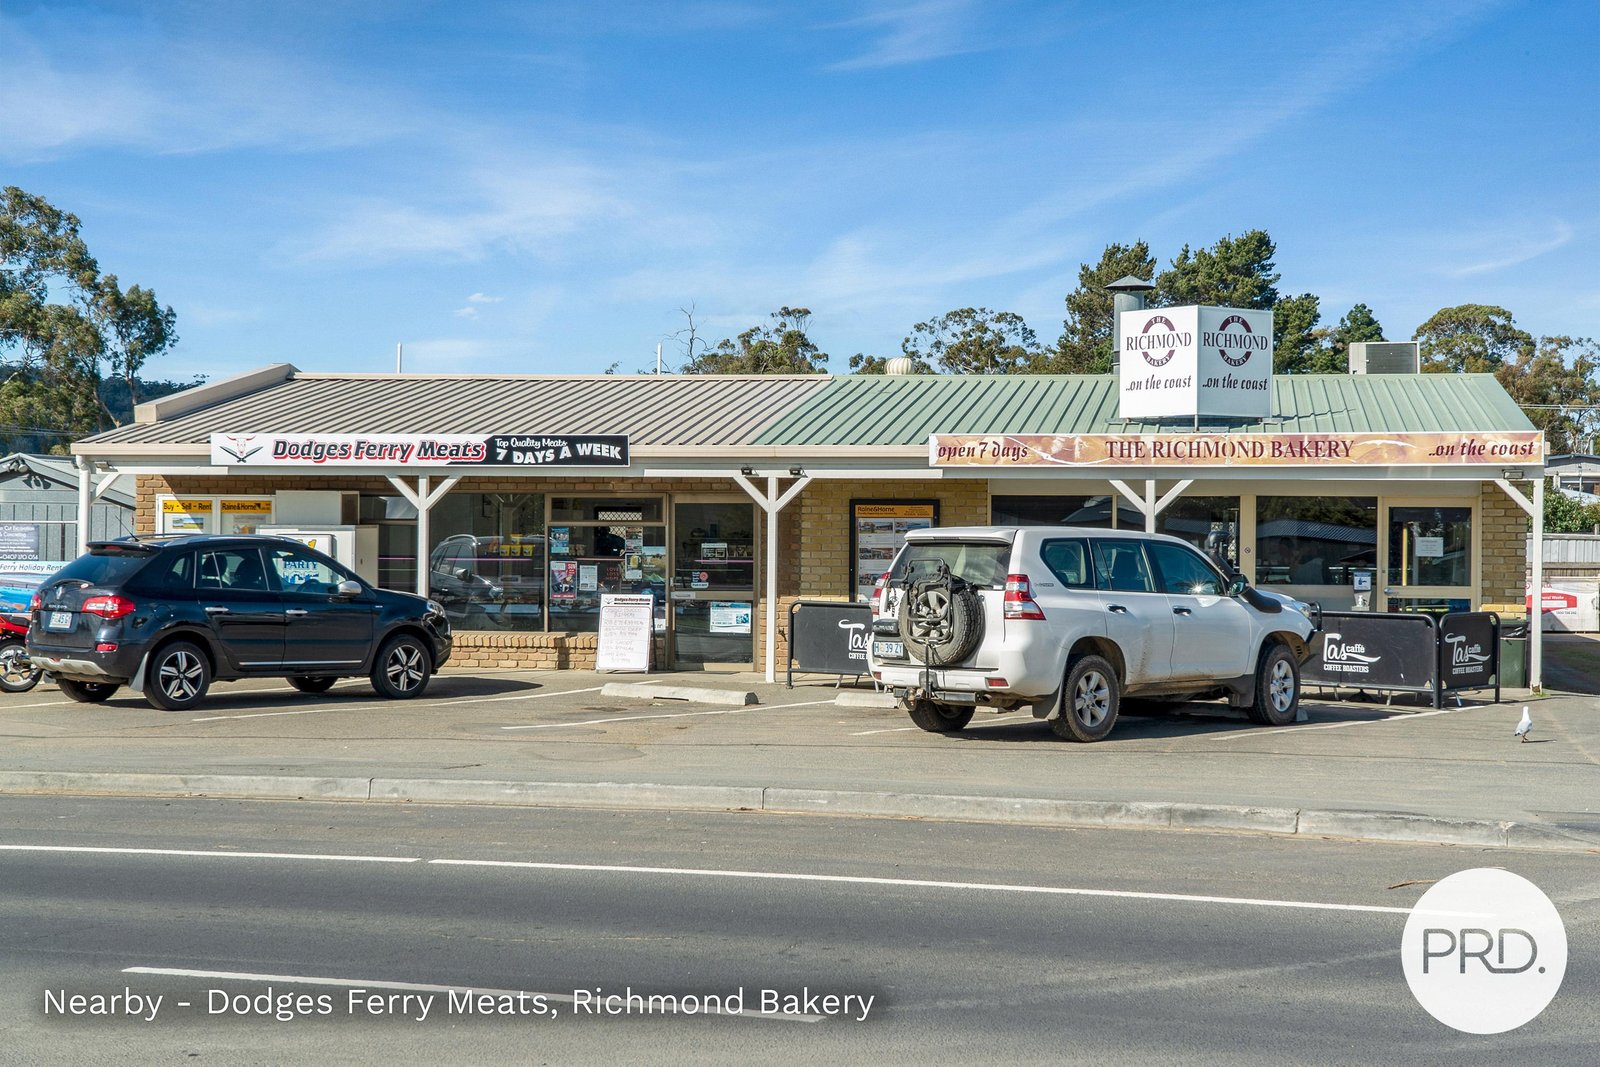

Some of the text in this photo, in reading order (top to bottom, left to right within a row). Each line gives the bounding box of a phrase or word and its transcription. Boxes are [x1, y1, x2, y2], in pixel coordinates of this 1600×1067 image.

[1126, 332, 1192, 350] RICHMOND
[1203, 332, 1268, 350] RICHMOND
[1146, 356, 1170, 367] BAKERY
[1224, 356, 1248, 367] BAKERY
[1145, 374, 1161, 390] the
[1165, 375, 1191, 389] coast
[1222, 373, 1238, 389] the
[1241, 378, 1268, 391] coast
[273, 439, 486, 463] Dodges Ferry Meats
[495, 438, 568, 449] Top Quality Meats
[938, 441, 1028, 461] open 7 days
[1106, 440, 1354, 458] THE RICHMOND BAKERY
[1460, 439, 1486, 456] the
[1491, 442, 1534, 456] coast
[496, 443, 622, 464] 7 DAYS A WEEK
[20, 564, 45, 572] Holiday
[1343, 665, 1369, 673] ROASTERS
